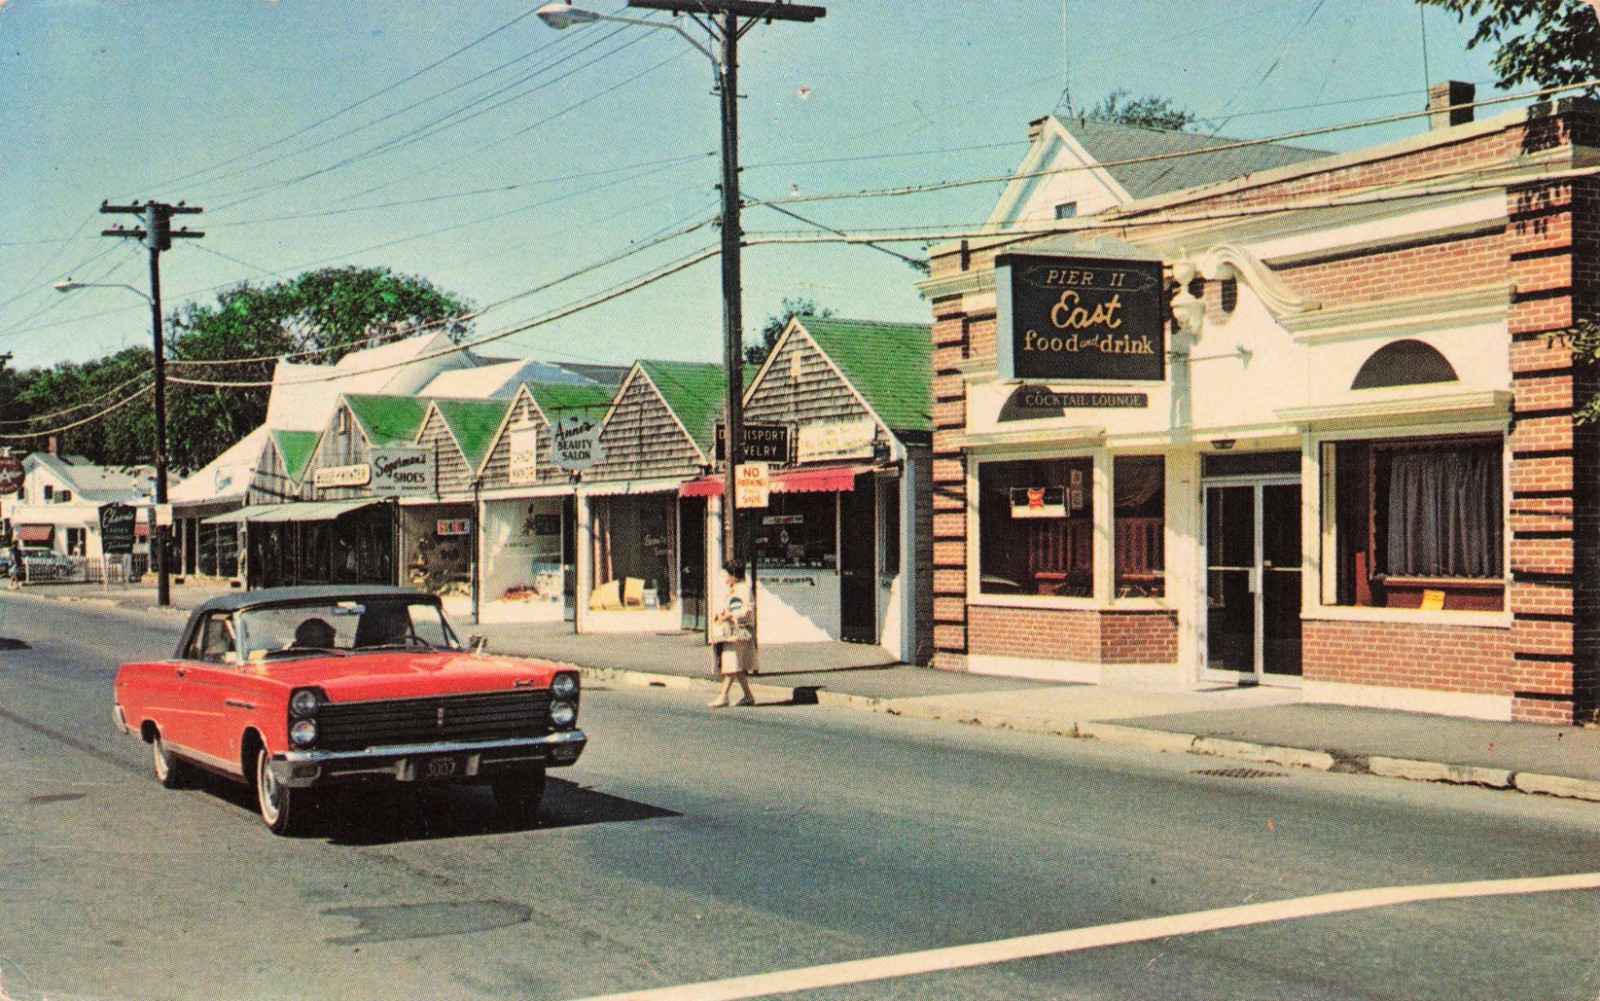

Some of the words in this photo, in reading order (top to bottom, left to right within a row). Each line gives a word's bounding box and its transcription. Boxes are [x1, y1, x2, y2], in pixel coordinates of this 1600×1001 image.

[1046, 269, 1094, 286] PIER
[1109, 272, 1127, 287] II
[1051, 289, 1122, 329] East
[1023, 329, 1079, 352] food
[1079, 333, 1099, 348] and
[1100, 334, 1154, 354] drink
[1025, 394, 1088, 407] COCKTAIL
[1092, 395, 1142, 407] LOUNGE
[557, 439, 594, 452] BEAUTY
[562, 450, 591, 461] SALON
[393, 471, 426, 483] SHOES
[743, 467, 760, 478] NO
